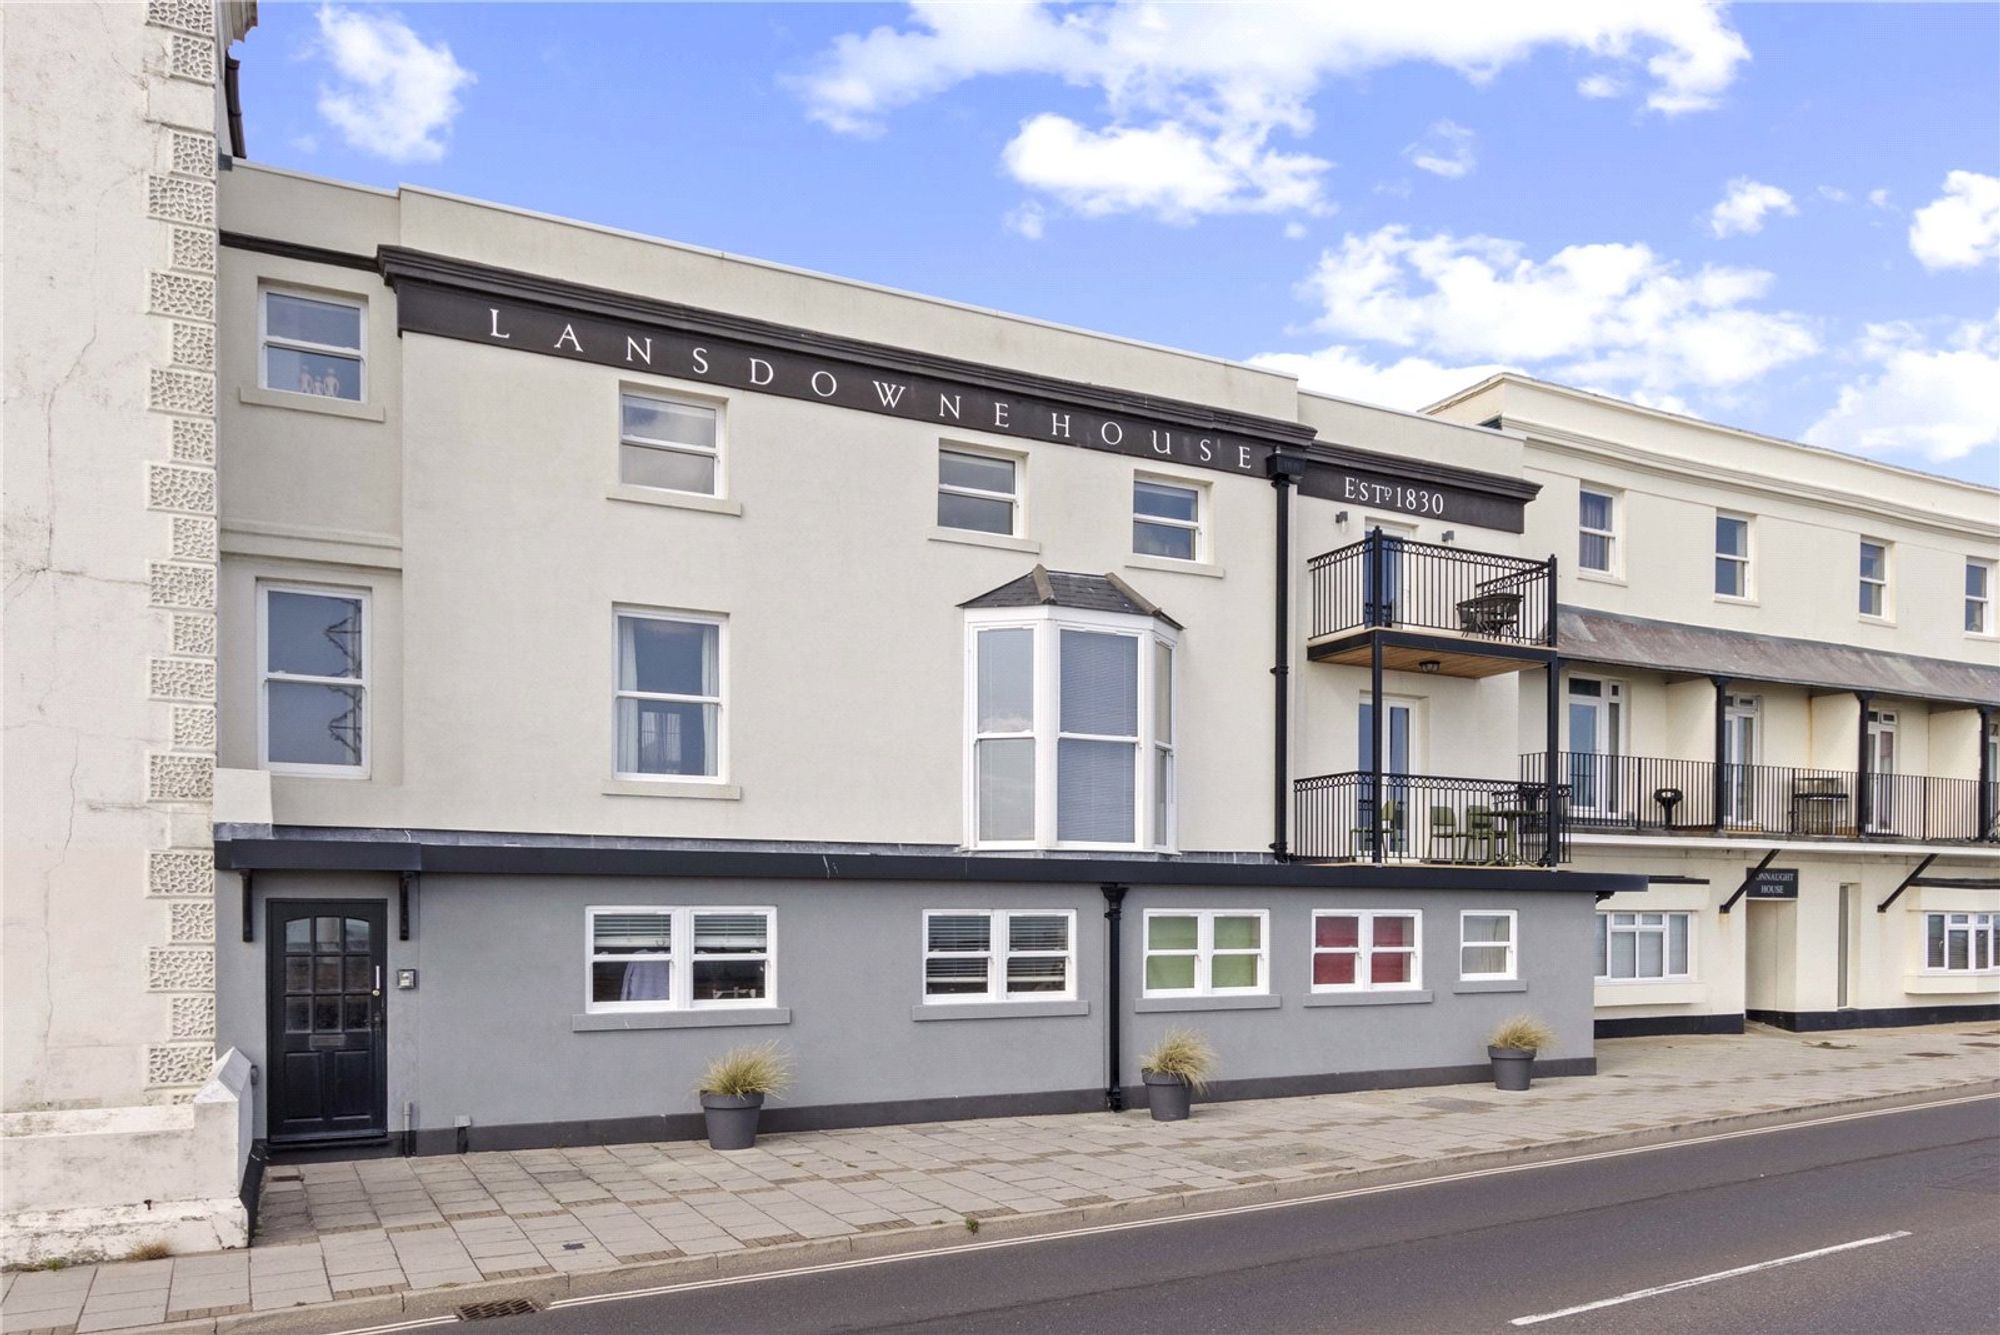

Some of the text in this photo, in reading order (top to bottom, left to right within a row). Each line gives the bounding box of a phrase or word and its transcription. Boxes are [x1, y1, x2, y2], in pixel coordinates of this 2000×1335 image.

[489, 308, 1252, 470] LANSDOWNE HOUSE
[1396, 486, 1444, 514] 1830
[1760, 885, 1784, 894] HOUSE
